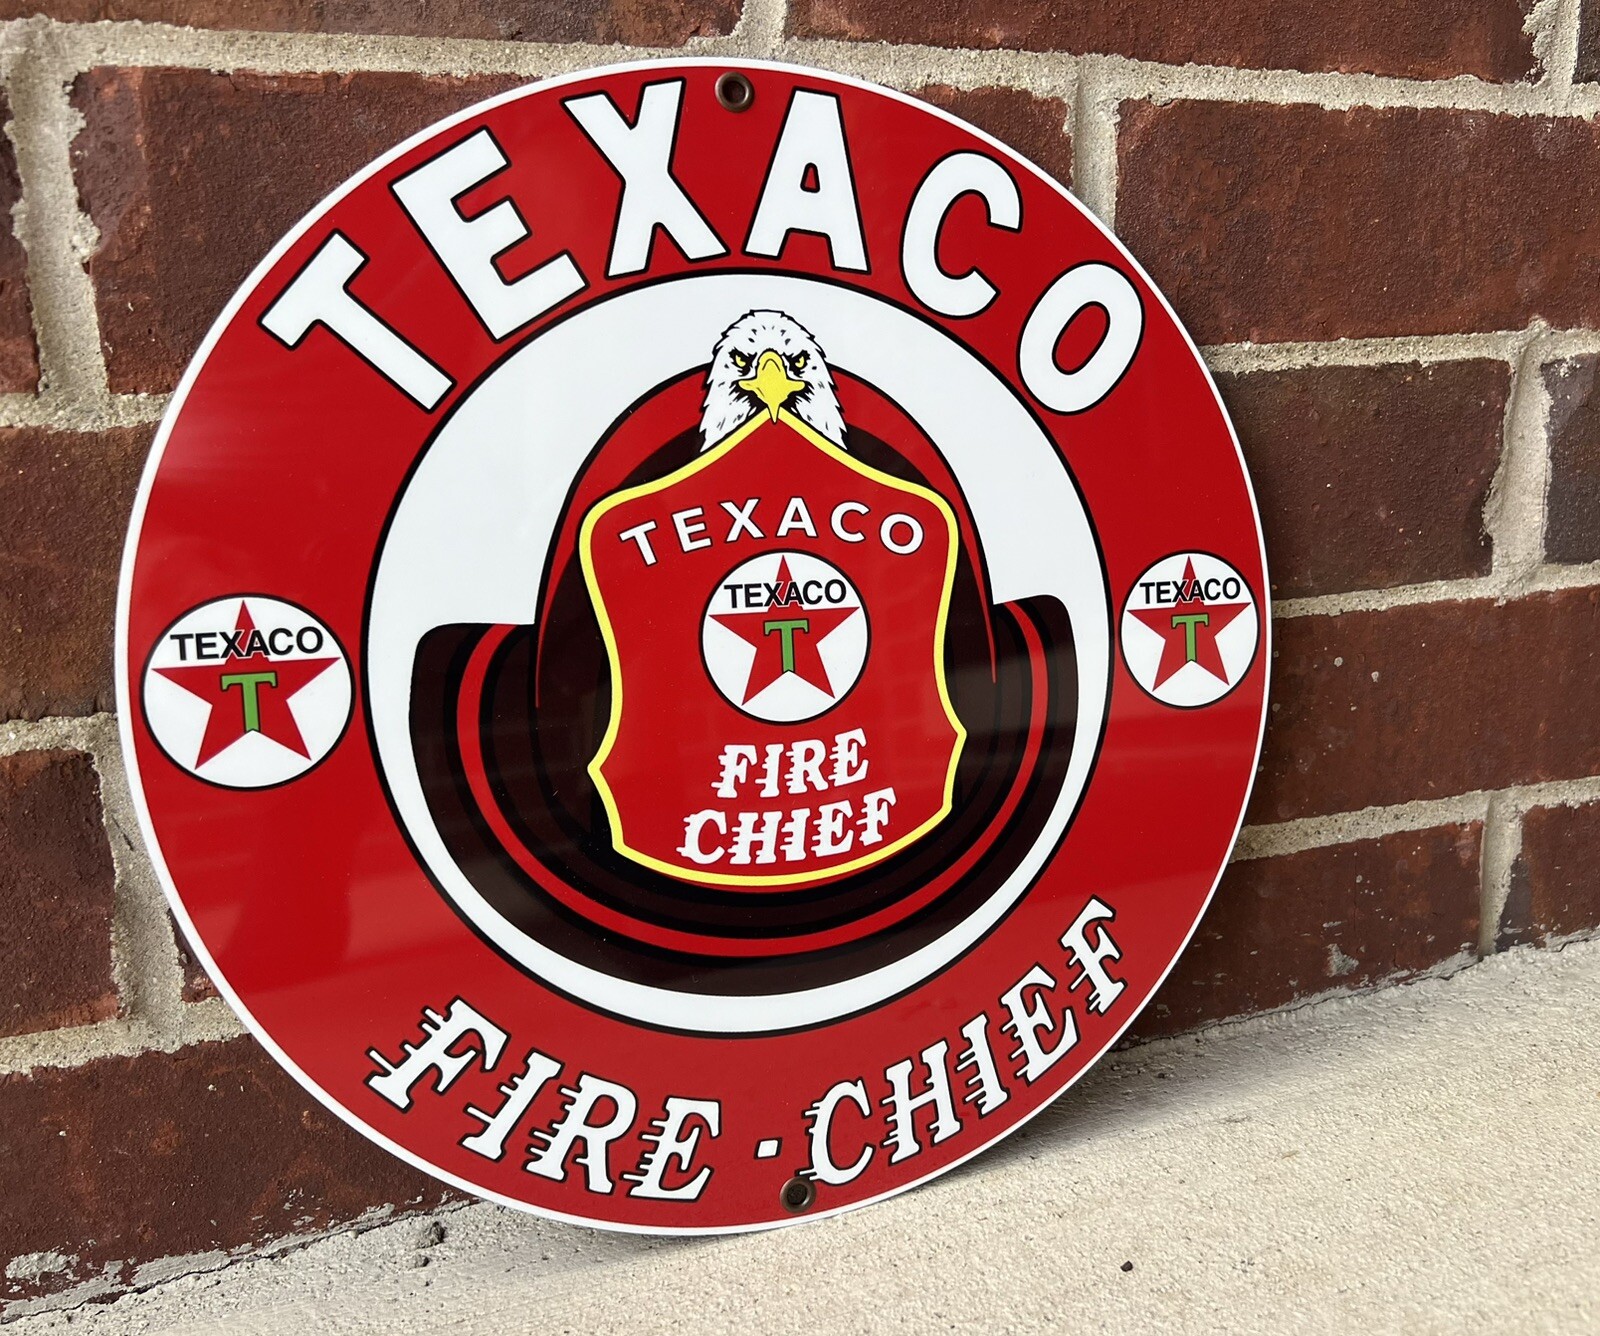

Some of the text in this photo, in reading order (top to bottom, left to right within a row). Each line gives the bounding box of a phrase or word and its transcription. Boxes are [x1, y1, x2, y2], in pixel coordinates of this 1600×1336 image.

[260, 79, 1145, 414] TEXACO
[619, 497, 924, 566] TEXACO
[723, 579, 847, 608] TEXACO
[1140, 578, 1240, 604] TEXACO
[170, 626, 323, 660] TEXACO
[765, 618, 808, 673] T
[1171, 613, 1209, 662] T
[221, 671, 278, 733] T
[711, 727, 869, 799] FIRE
[677, 787, 897, 865] CHIEF
[366, 897, 1127, 1200] FIRE CHIEF
